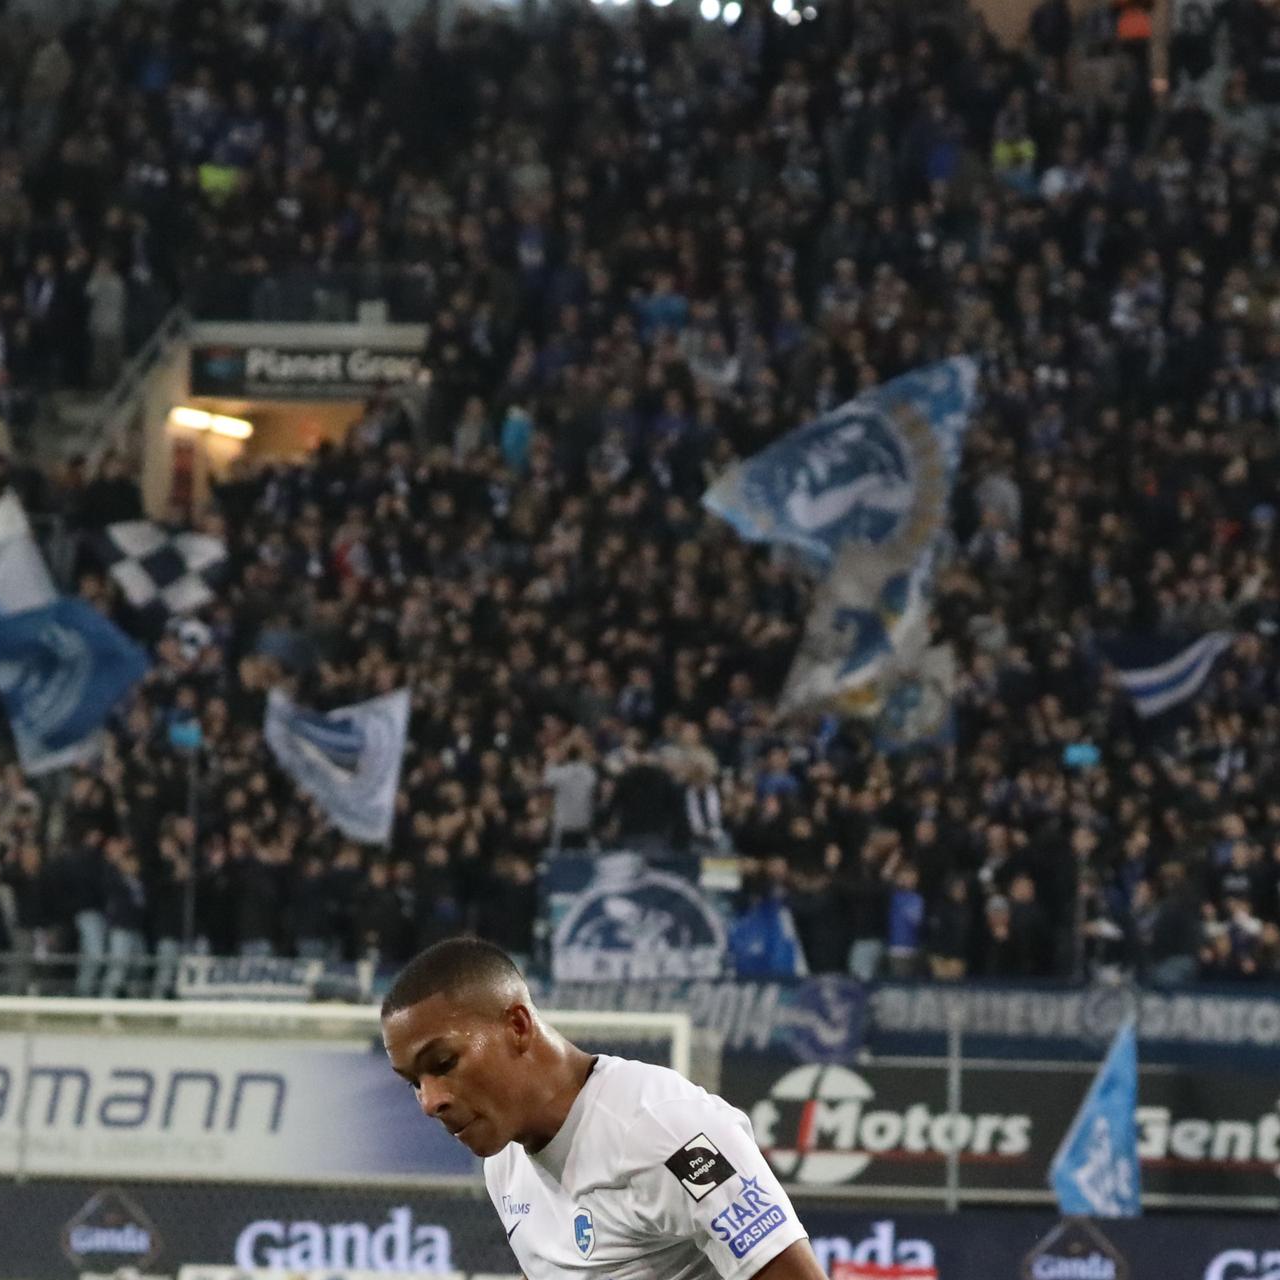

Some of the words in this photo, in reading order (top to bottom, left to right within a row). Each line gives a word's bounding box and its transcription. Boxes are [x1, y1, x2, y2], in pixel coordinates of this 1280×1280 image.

[811, 1097, 1032, 1158] Motors
[688, 1159, 716, 1181] League
[689, 1156, 704, 1168] Pro
[233, 1205, 454, 1272] Ganda
[710, 1188, 771, 1242] STAR
[734, 1209, 784, 1252] CASINO
